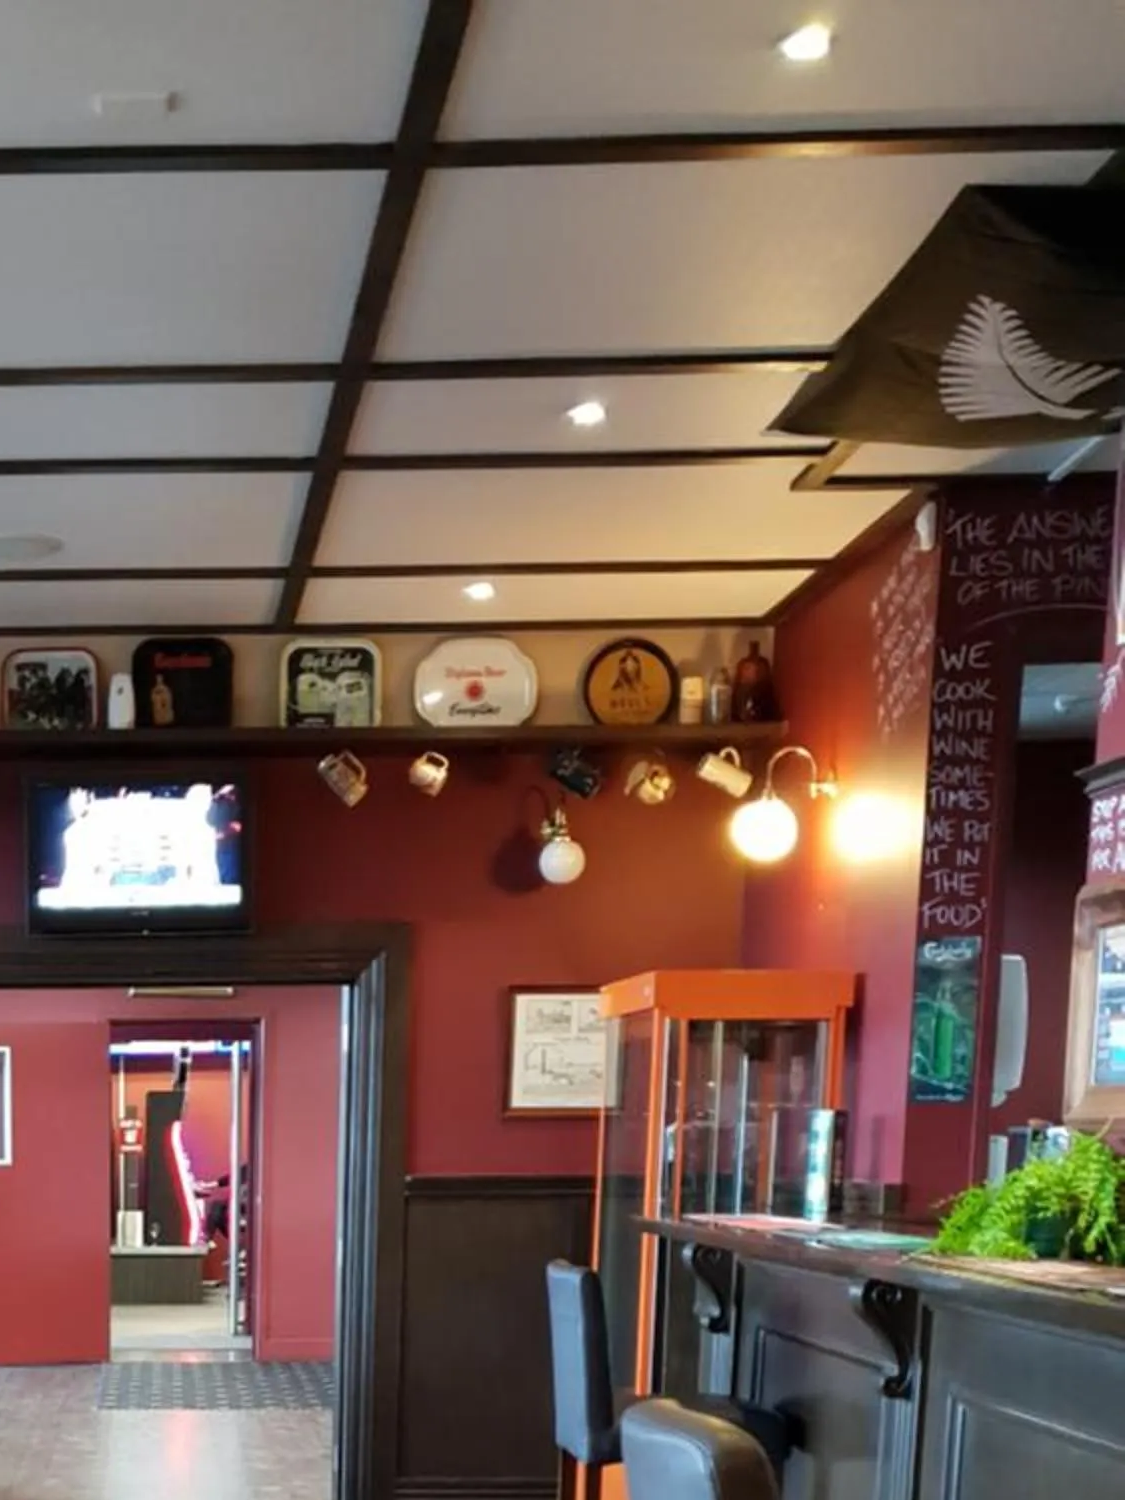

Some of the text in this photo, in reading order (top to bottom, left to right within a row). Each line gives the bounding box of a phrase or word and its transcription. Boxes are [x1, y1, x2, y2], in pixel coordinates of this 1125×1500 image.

[950, 546, 1106, 577] LIES IN THE
[957, 581, 988, 605] OF
[994, 579, 1039, 601] THE
[940, 641, 994, 670] WE
[933, 677, 997, 703] COOK
[933, 707, 993, 733] WITH
[931, 735, 991, 760] WINE
[929, 787, 990, 811] TIMES
[925, 815, 992, 843] WE PUT
[925, 844, 980, 866] IT IN
[925, 870, 981, 897] THE
